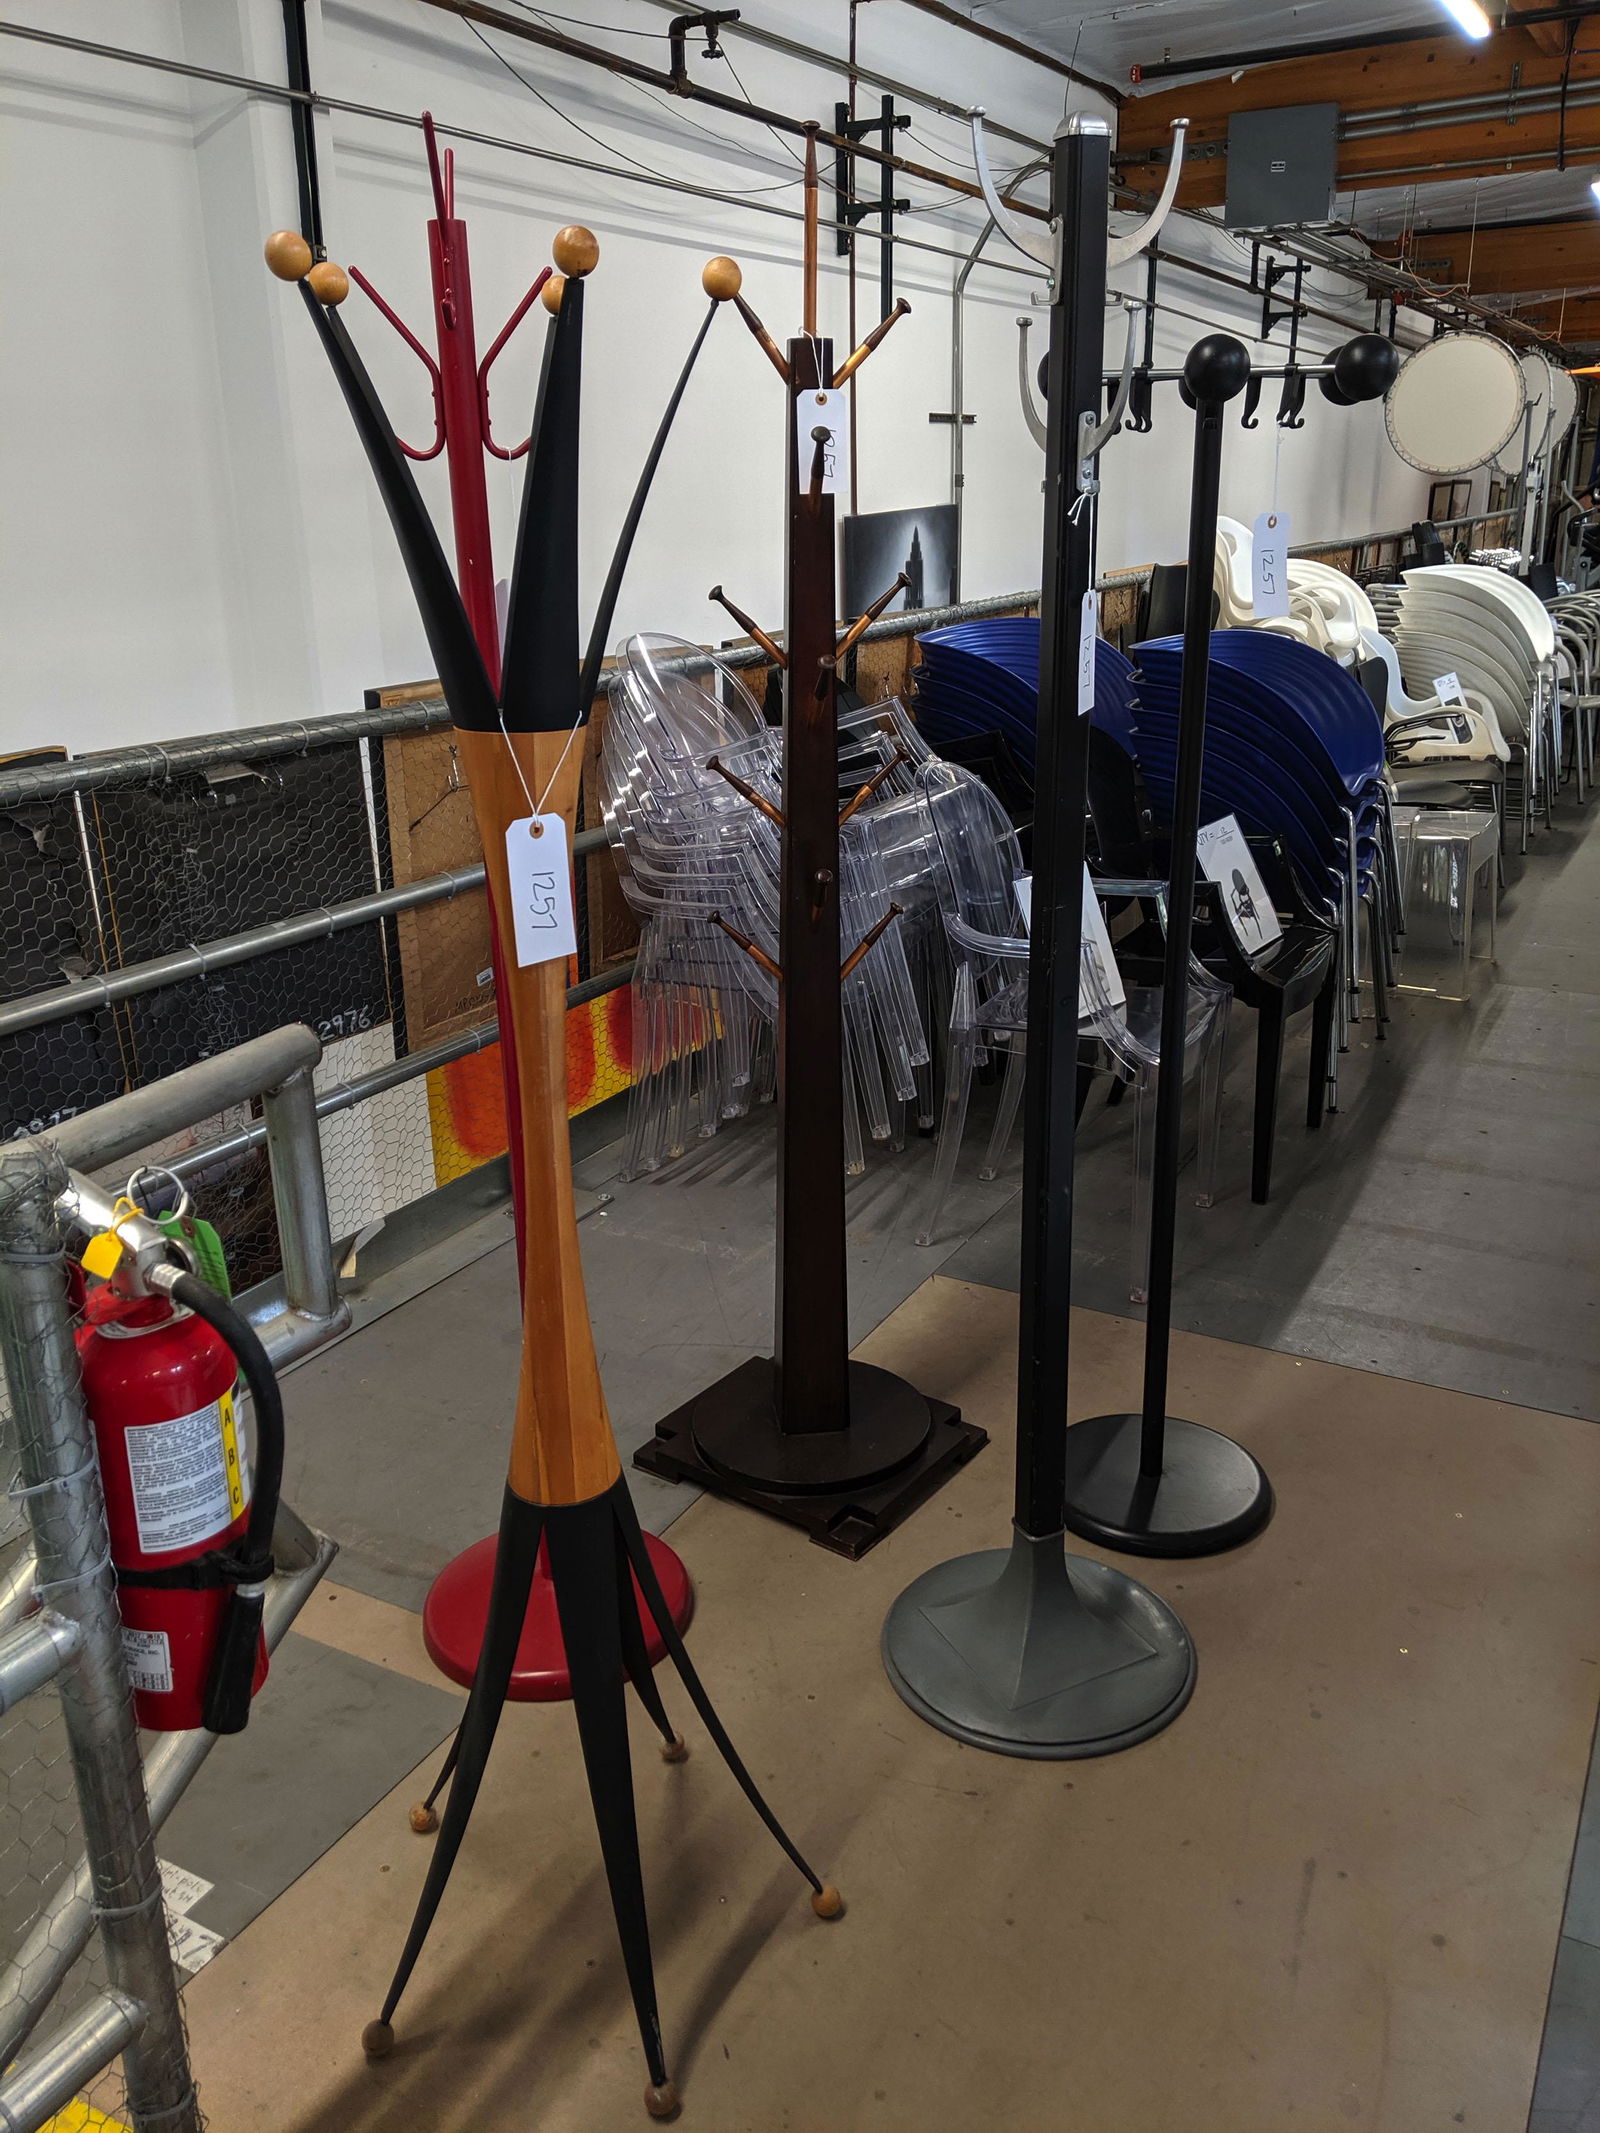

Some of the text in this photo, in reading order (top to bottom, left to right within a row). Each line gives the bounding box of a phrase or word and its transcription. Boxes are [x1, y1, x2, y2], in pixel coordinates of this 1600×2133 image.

[1261, 549, 1276, 595] 1257
[530, 871, 558, 929] 1257
[318, 1004, 371, 1041] 2976
[225, 1407, 239, 1504] A B C
